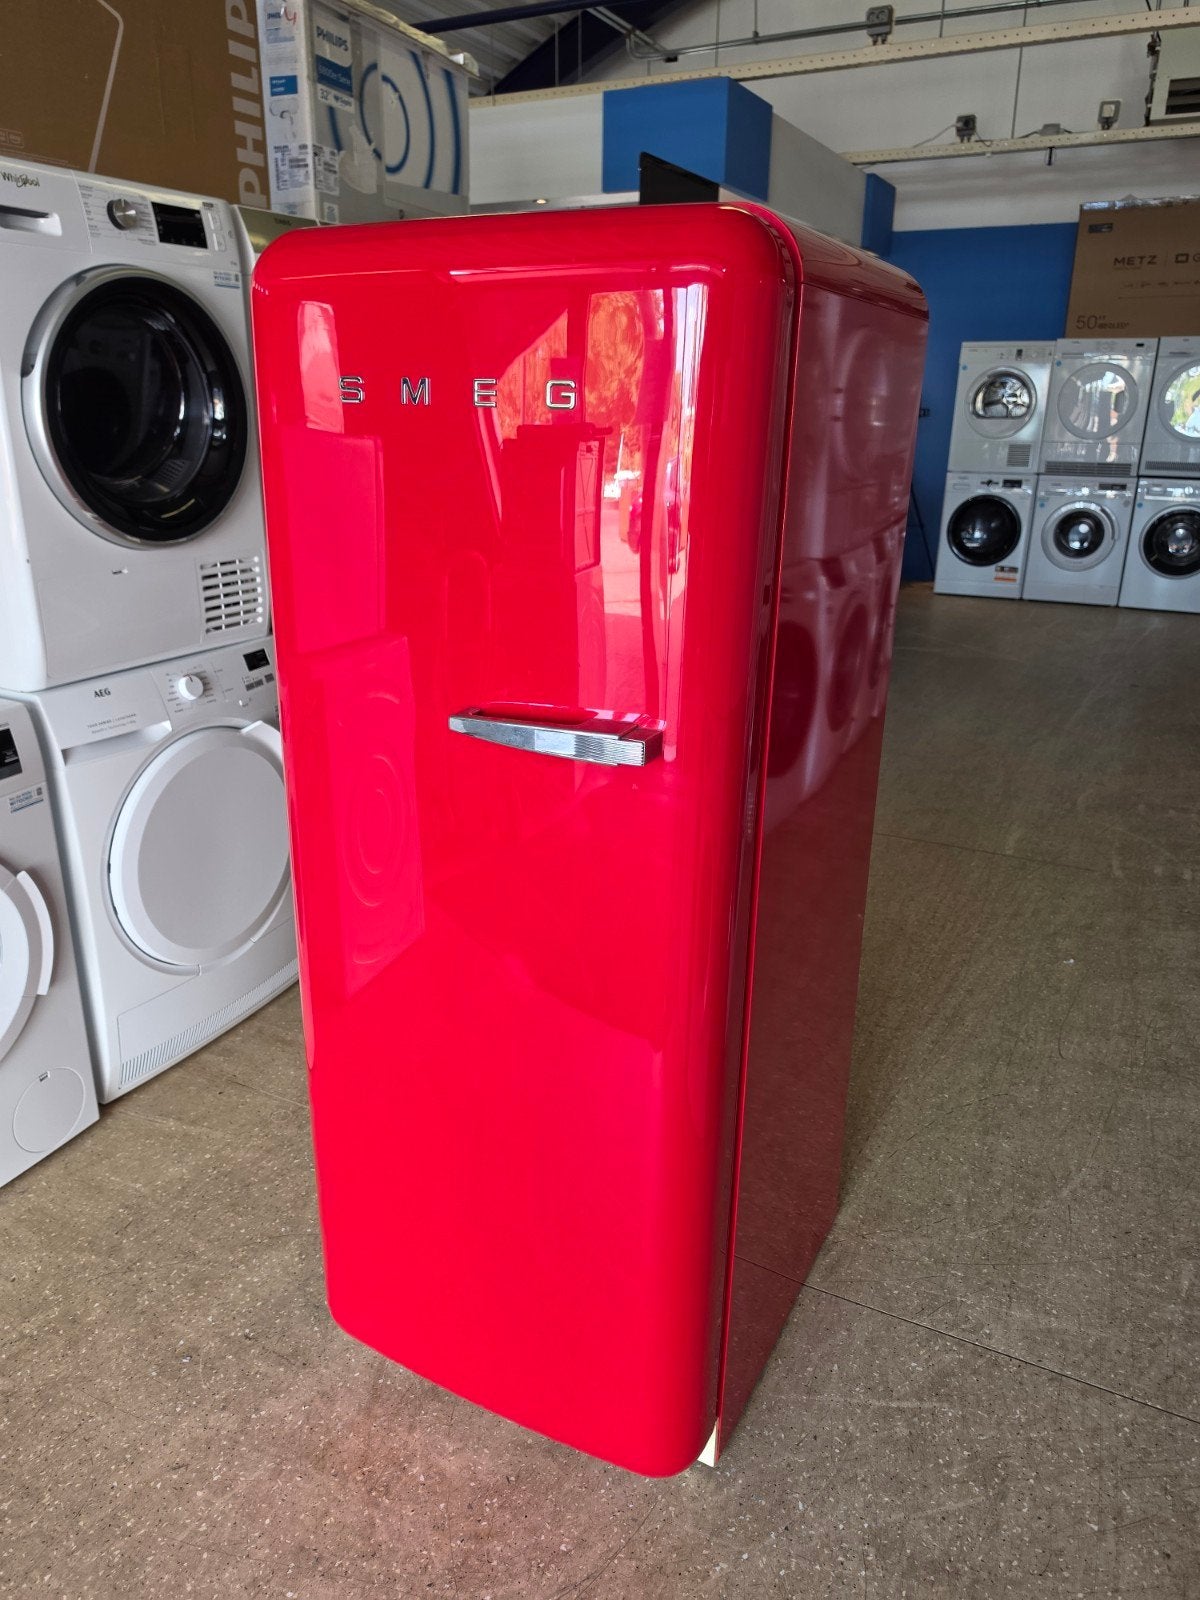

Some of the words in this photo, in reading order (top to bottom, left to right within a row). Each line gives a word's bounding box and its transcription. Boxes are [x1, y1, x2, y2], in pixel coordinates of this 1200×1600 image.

[316, 26, 349, 52] PHILIPS
[0, 171, 41, 188] Whirlpool
[1113, 255, 1157, 266] METZ
[94, 687, 111, 698] AEG
